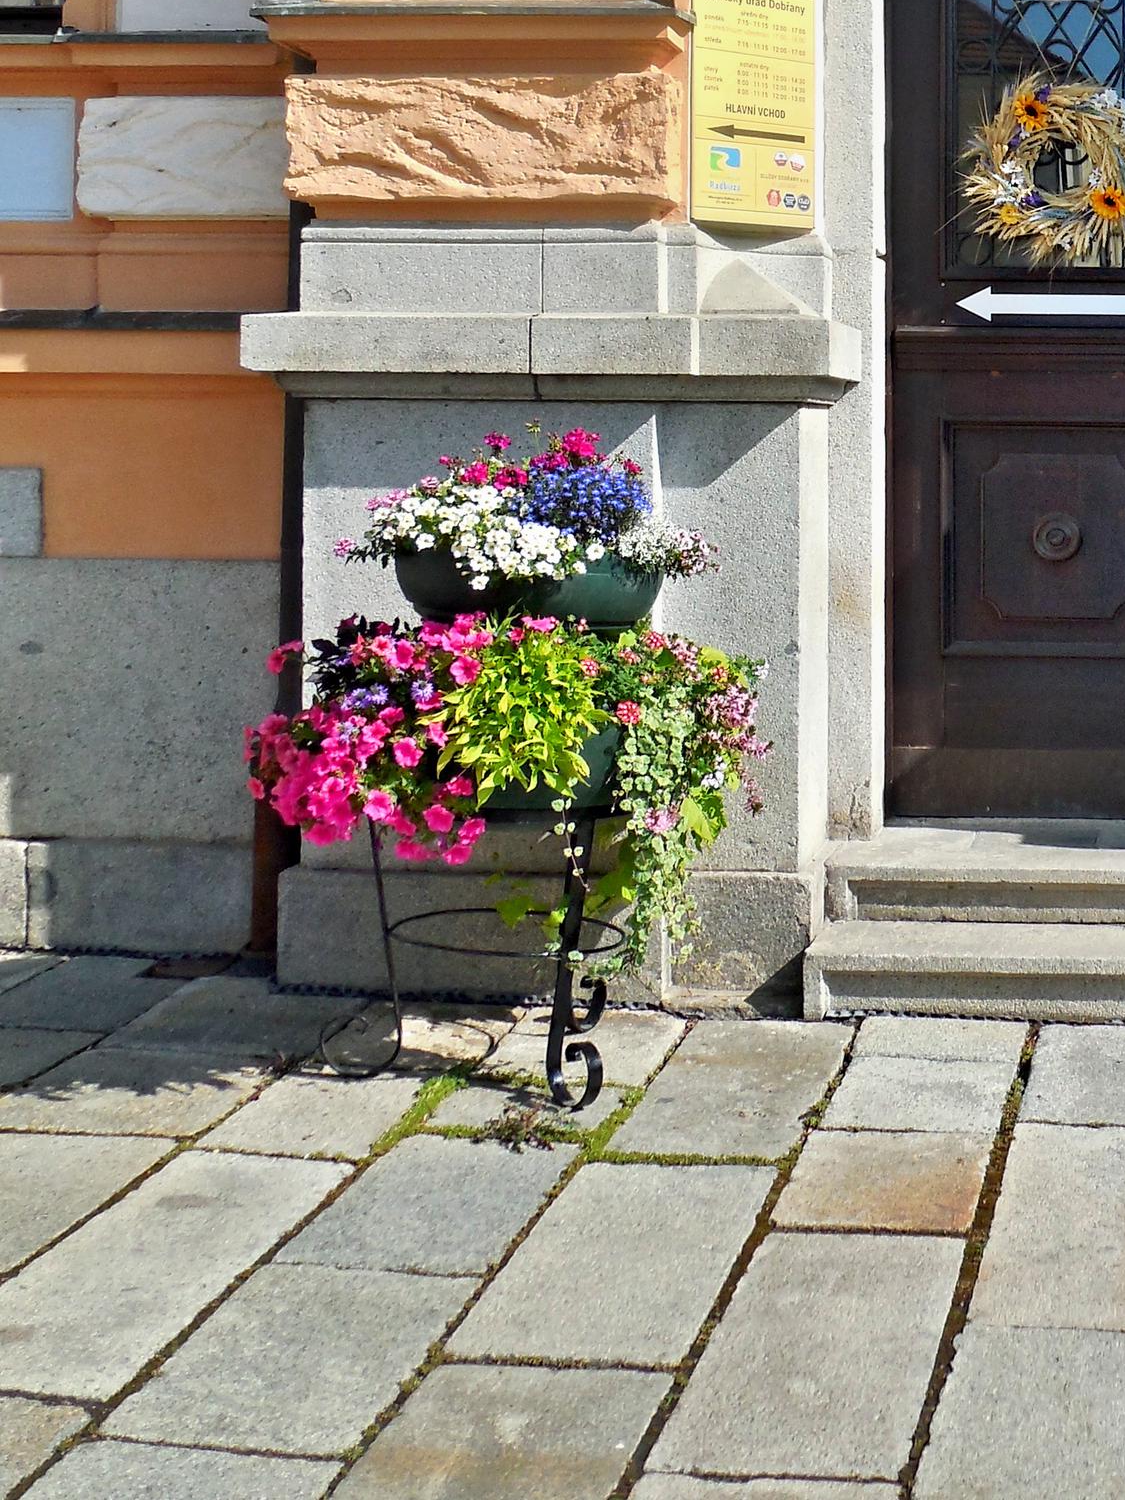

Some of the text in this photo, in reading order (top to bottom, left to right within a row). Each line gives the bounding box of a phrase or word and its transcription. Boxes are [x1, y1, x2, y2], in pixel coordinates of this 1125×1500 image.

[769, 0, 805, 16] Dobřany
[726, 103, 786, 119] HLAVNÍ VCHOD
